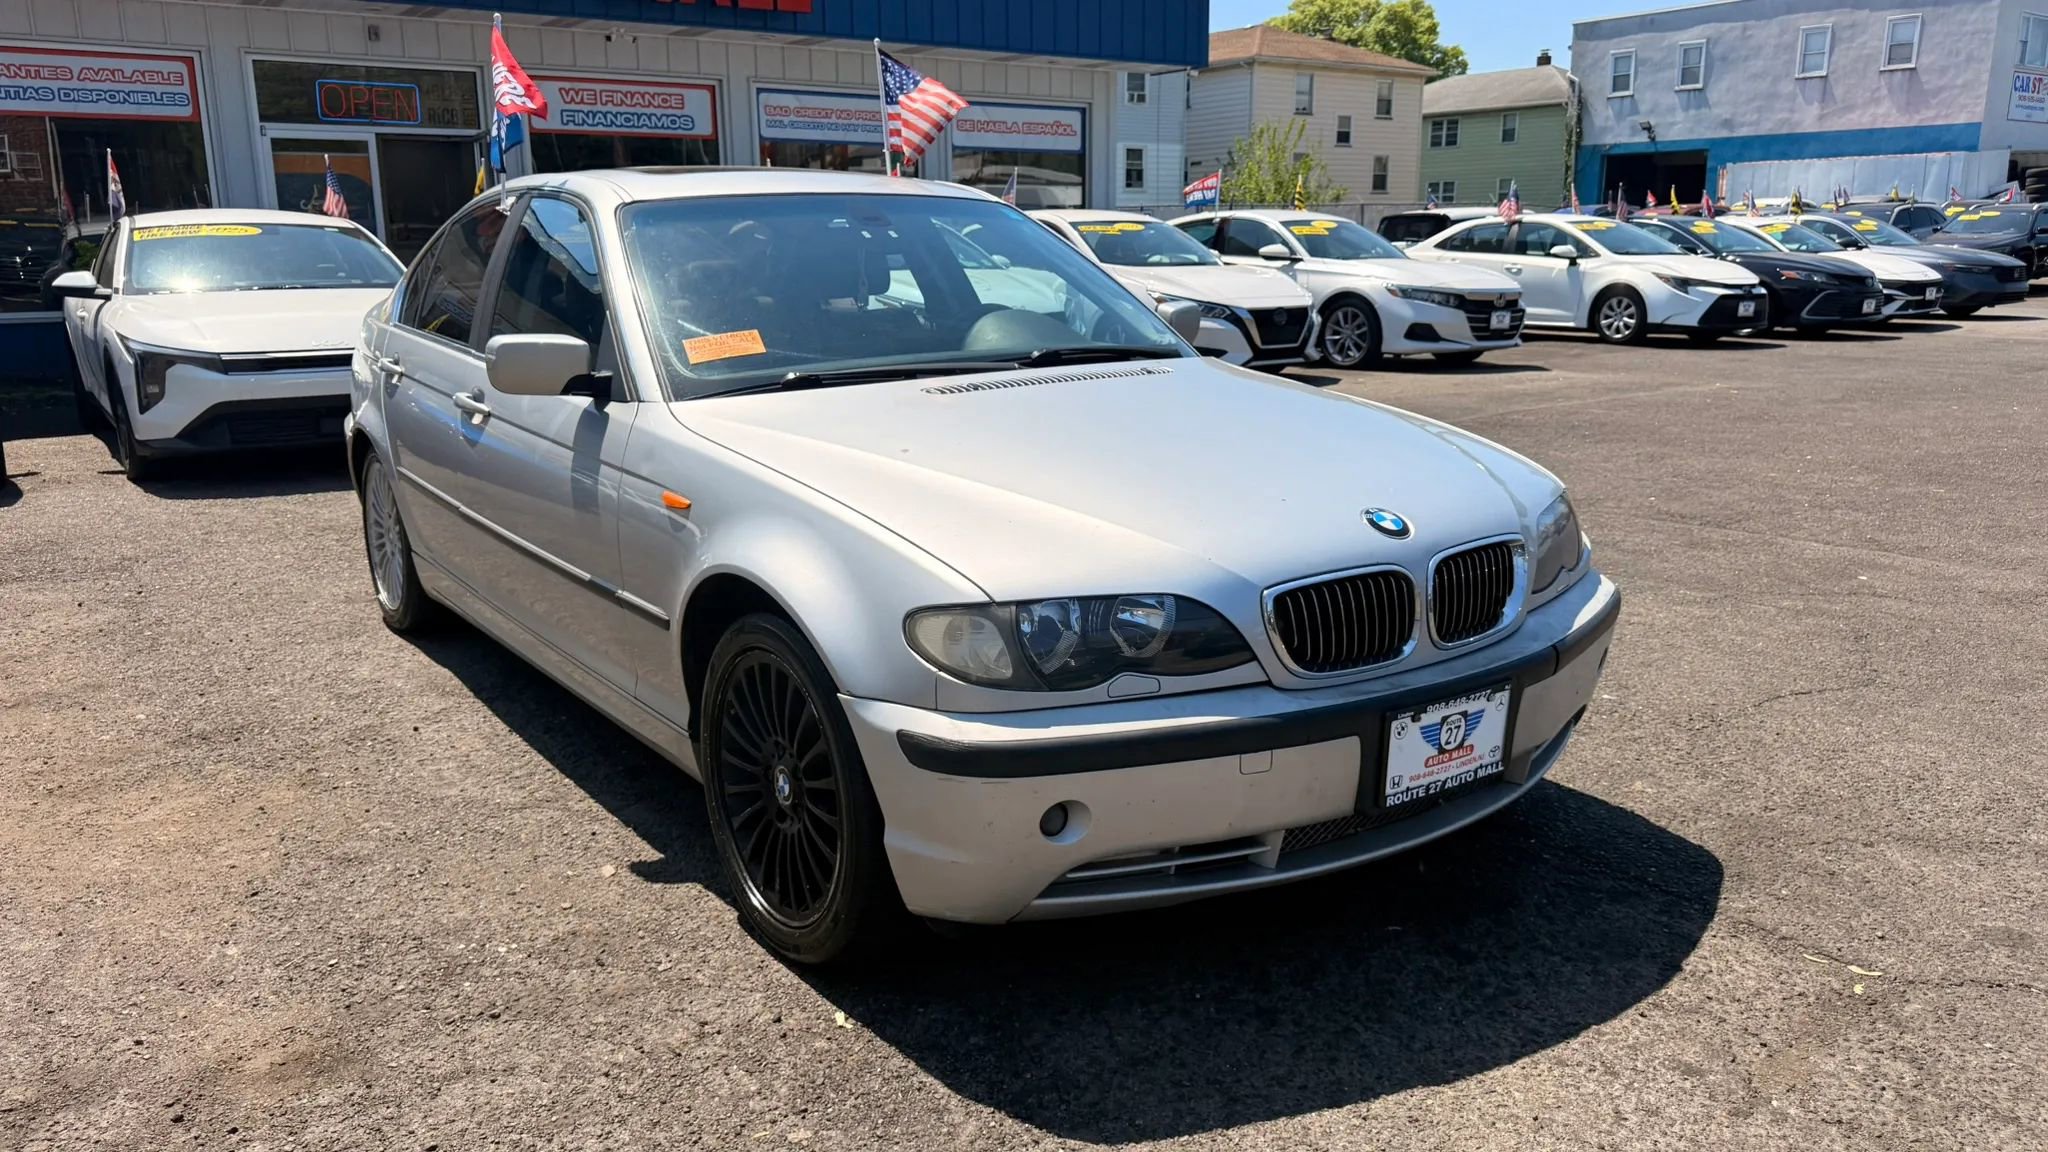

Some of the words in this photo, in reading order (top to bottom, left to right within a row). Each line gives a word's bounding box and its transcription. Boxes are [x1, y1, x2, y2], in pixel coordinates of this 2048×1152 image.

[77, 67, 184, 86] AVAILABLE
[2014, 75, 2031, 93] CAR
[57, 88, 191, 106] DISPONIBLES
[321, 84, 417, 121] OPEN
[559, 87, 598, 105] WE
[600, 91, 684, 109] FINANCE
[560, 109, 695, 131] FINANCIAMOS
[765, 105, 791, 117] BAD
[791, 106, 833, 119] CREDIT
[835, 109, 854, 120] NO
[765, 119, 787, 129] MAL
[826, 122, 841, 131] NO
[957, 119, 976, 132] SE
[976, 120, 1020, 134] HABLA
[1022, 120, 1077, 136] ESPAÑOL
[1445, 717, 1462, 727] ROUTE
[1444, 725, 1461, 746] 27
[1427, 753, 1449, 766] AUTO
[1451, 746, 1472, 758] MALL
[1386, 786, 1426, 807] ROUTE
[1428, 781, 1443, 794] 27
[1444, 772, 1474, 789] AUTO
[1476, 762, 1504, 779] MALL
